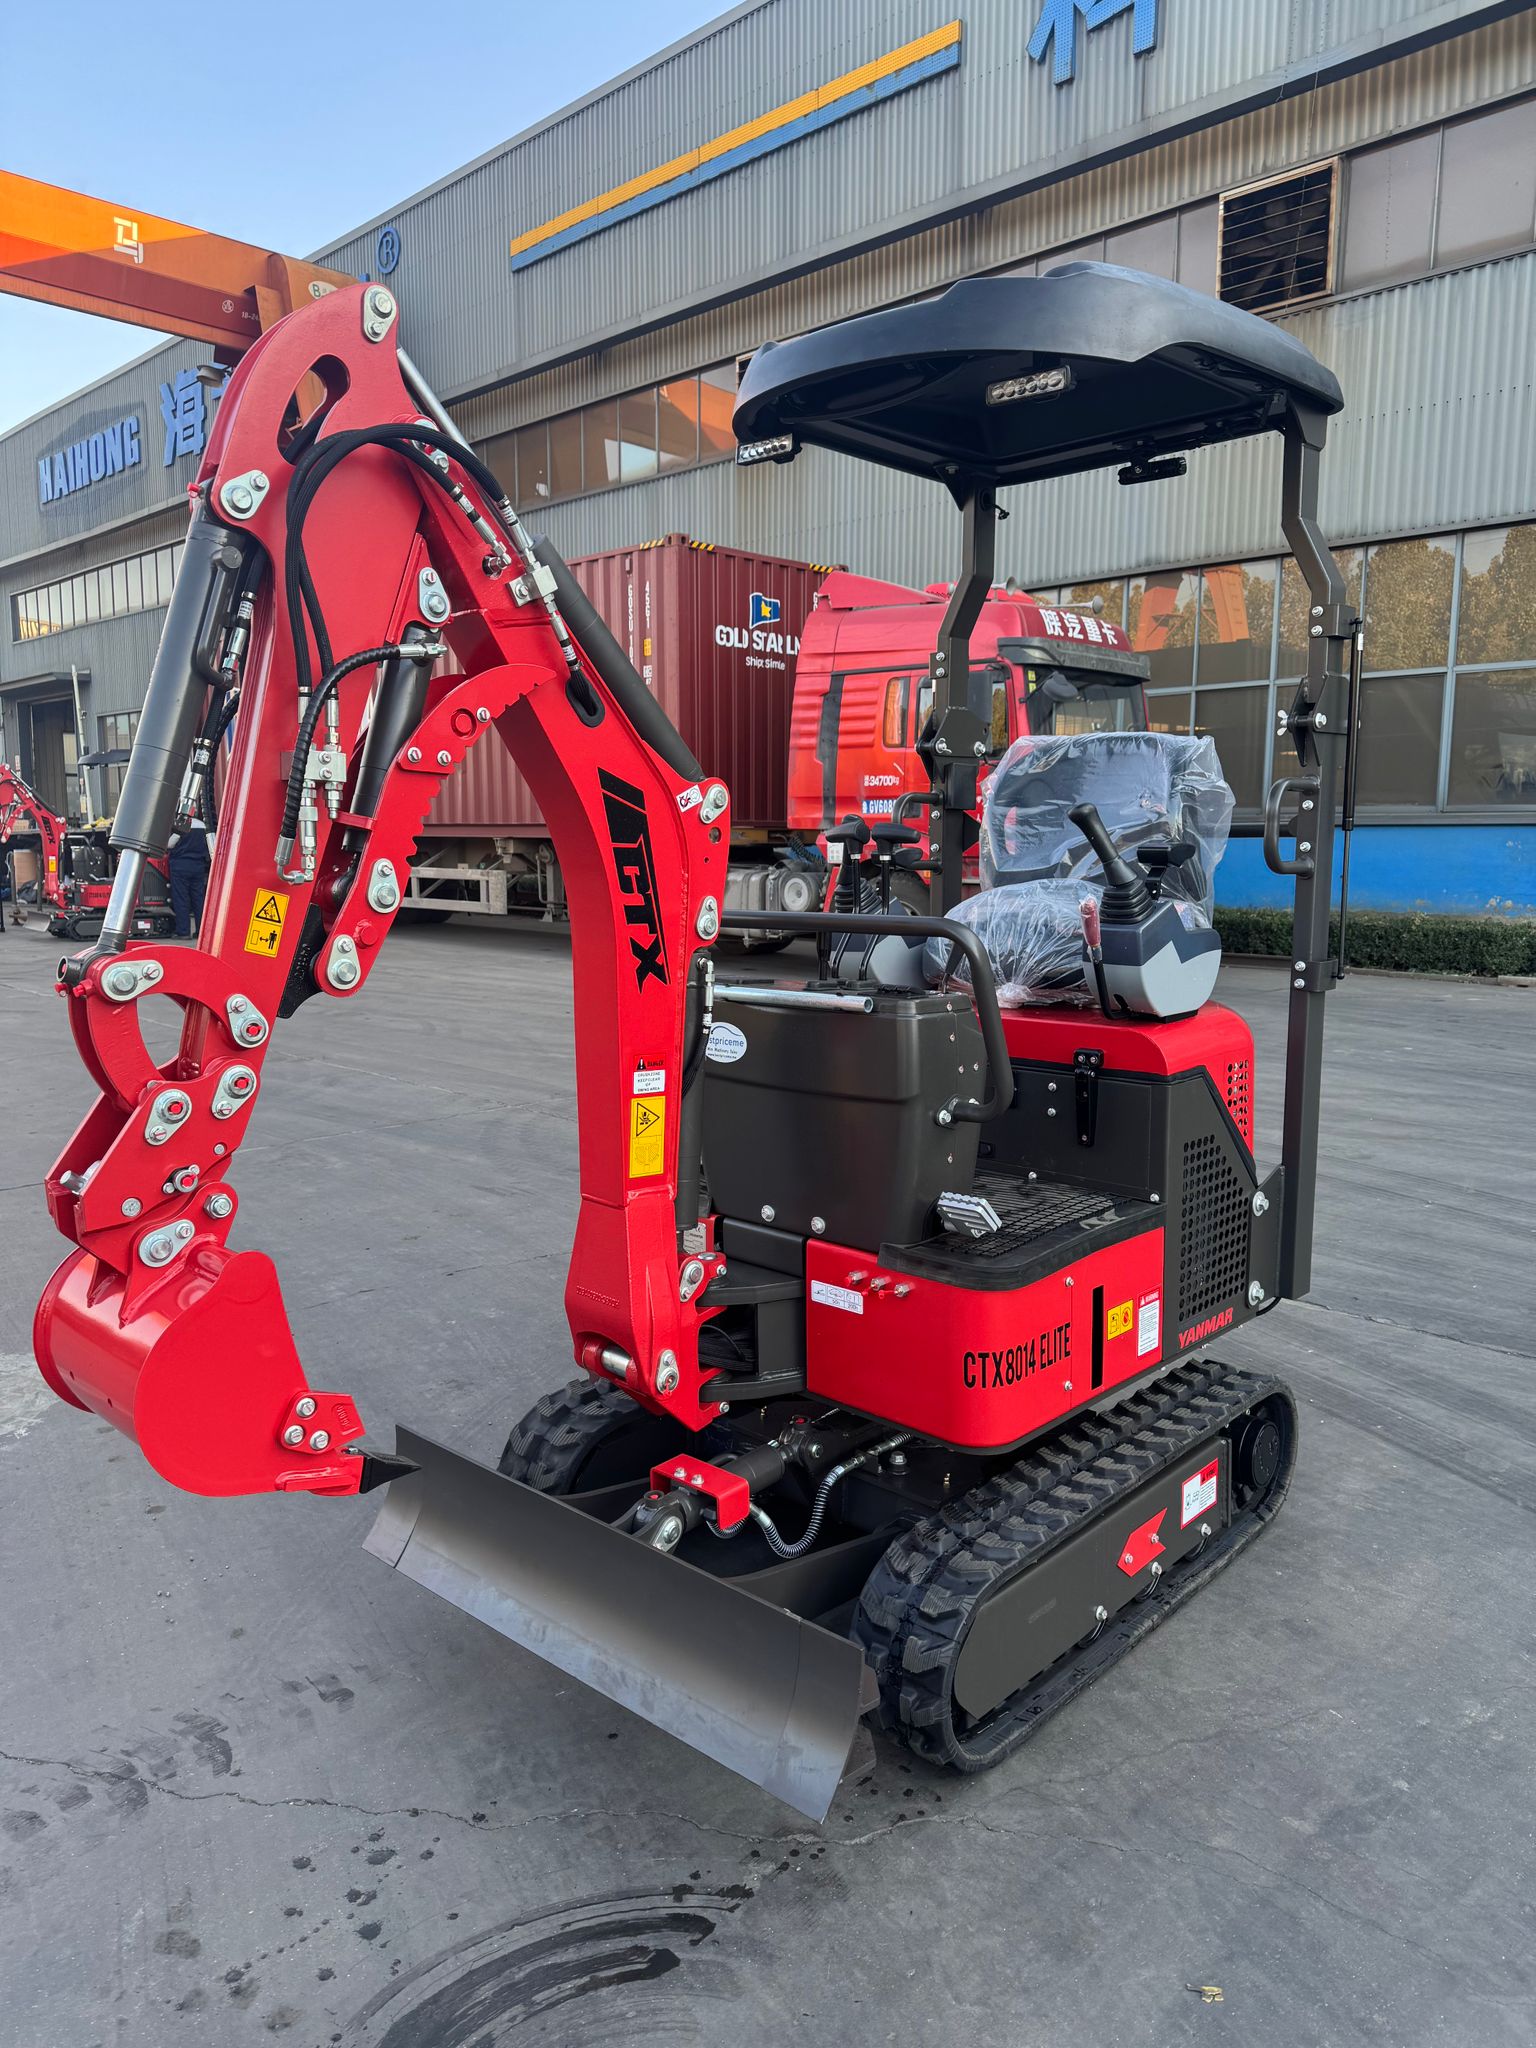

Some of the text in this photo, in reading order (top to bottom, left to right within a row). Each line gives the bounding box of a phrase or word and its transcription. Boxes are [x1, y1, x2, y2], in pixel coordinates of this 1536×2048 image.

[38, 416, 140, 504] HAIHONG
[715, 624, 749, 649] GOLD
[752, 630, 783, 654] STAR
[1039, 608, 1118, 645] 陕汽重卡
[709, 1036, 744, 1047] stpriceme
[1178, 1306, 1233, 1349] YANMAR
[963, 1322, 1071, 1389] CTX8014 ELITE
